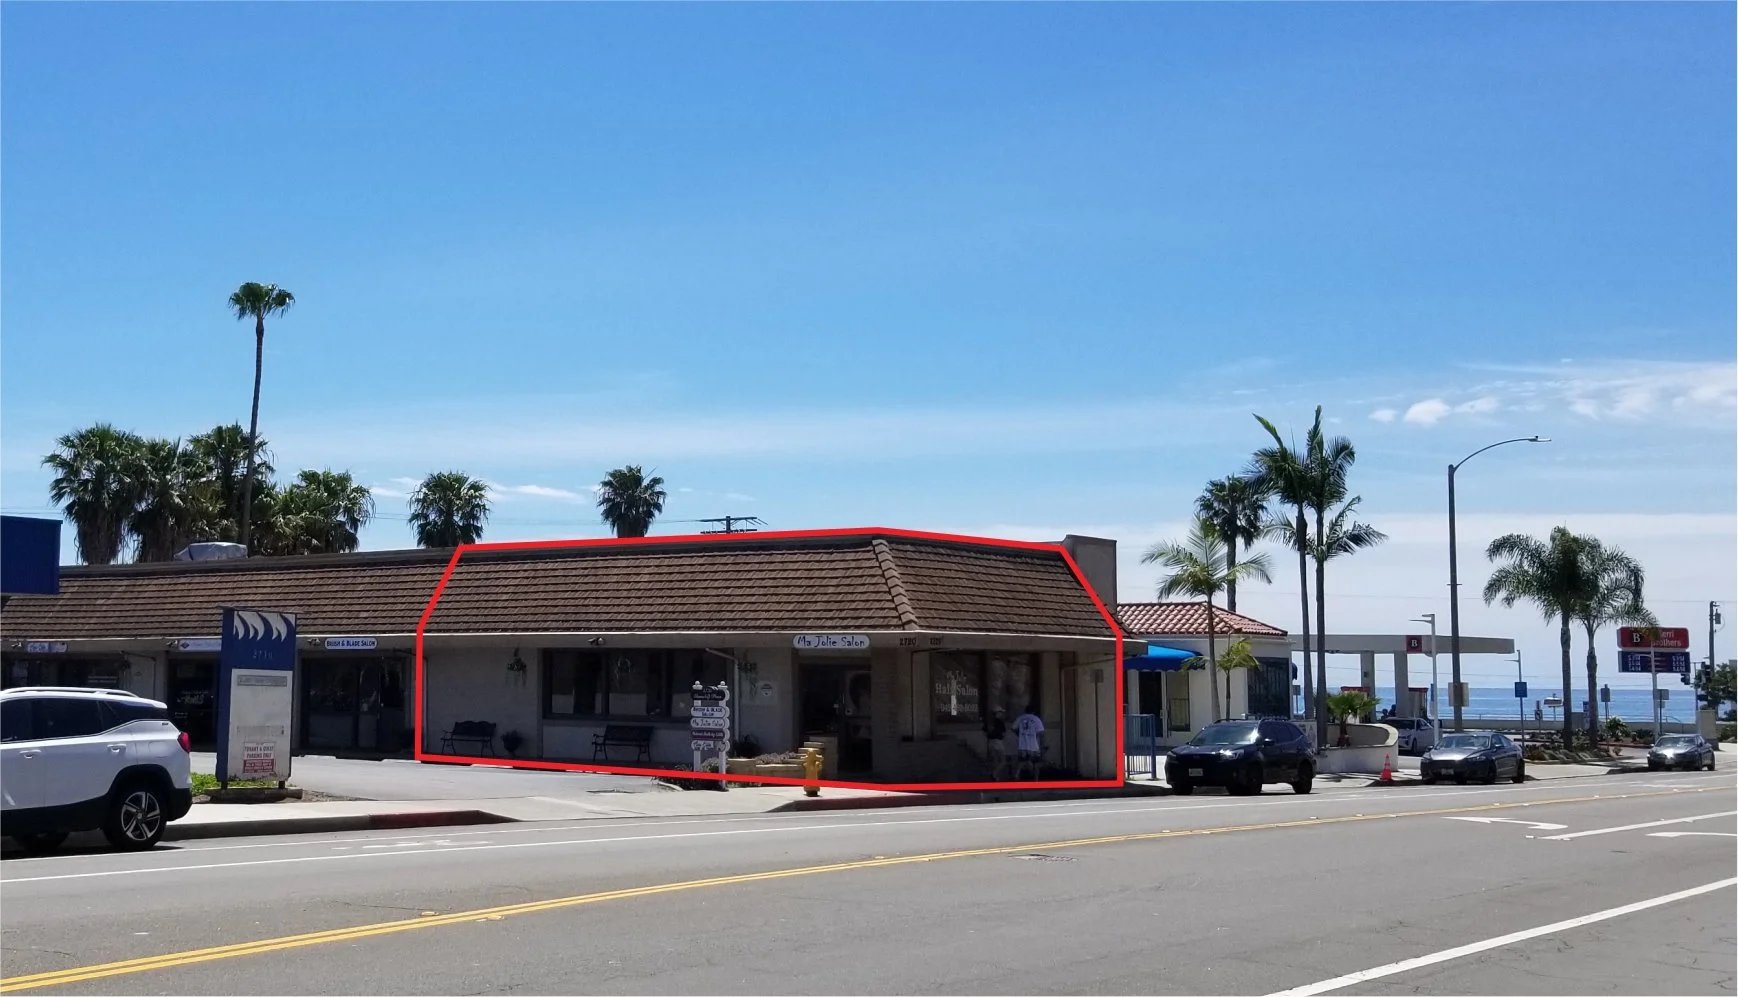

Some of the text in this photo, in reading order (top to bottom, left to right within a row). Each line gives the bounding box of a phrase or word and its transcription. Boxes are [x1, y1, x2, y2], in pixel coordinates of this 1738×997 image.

[797, 635, 865, 648] Ma Jolie Salon
[1411, 639, 1418, 647] B
[1633, 633, 1641, 643] B
